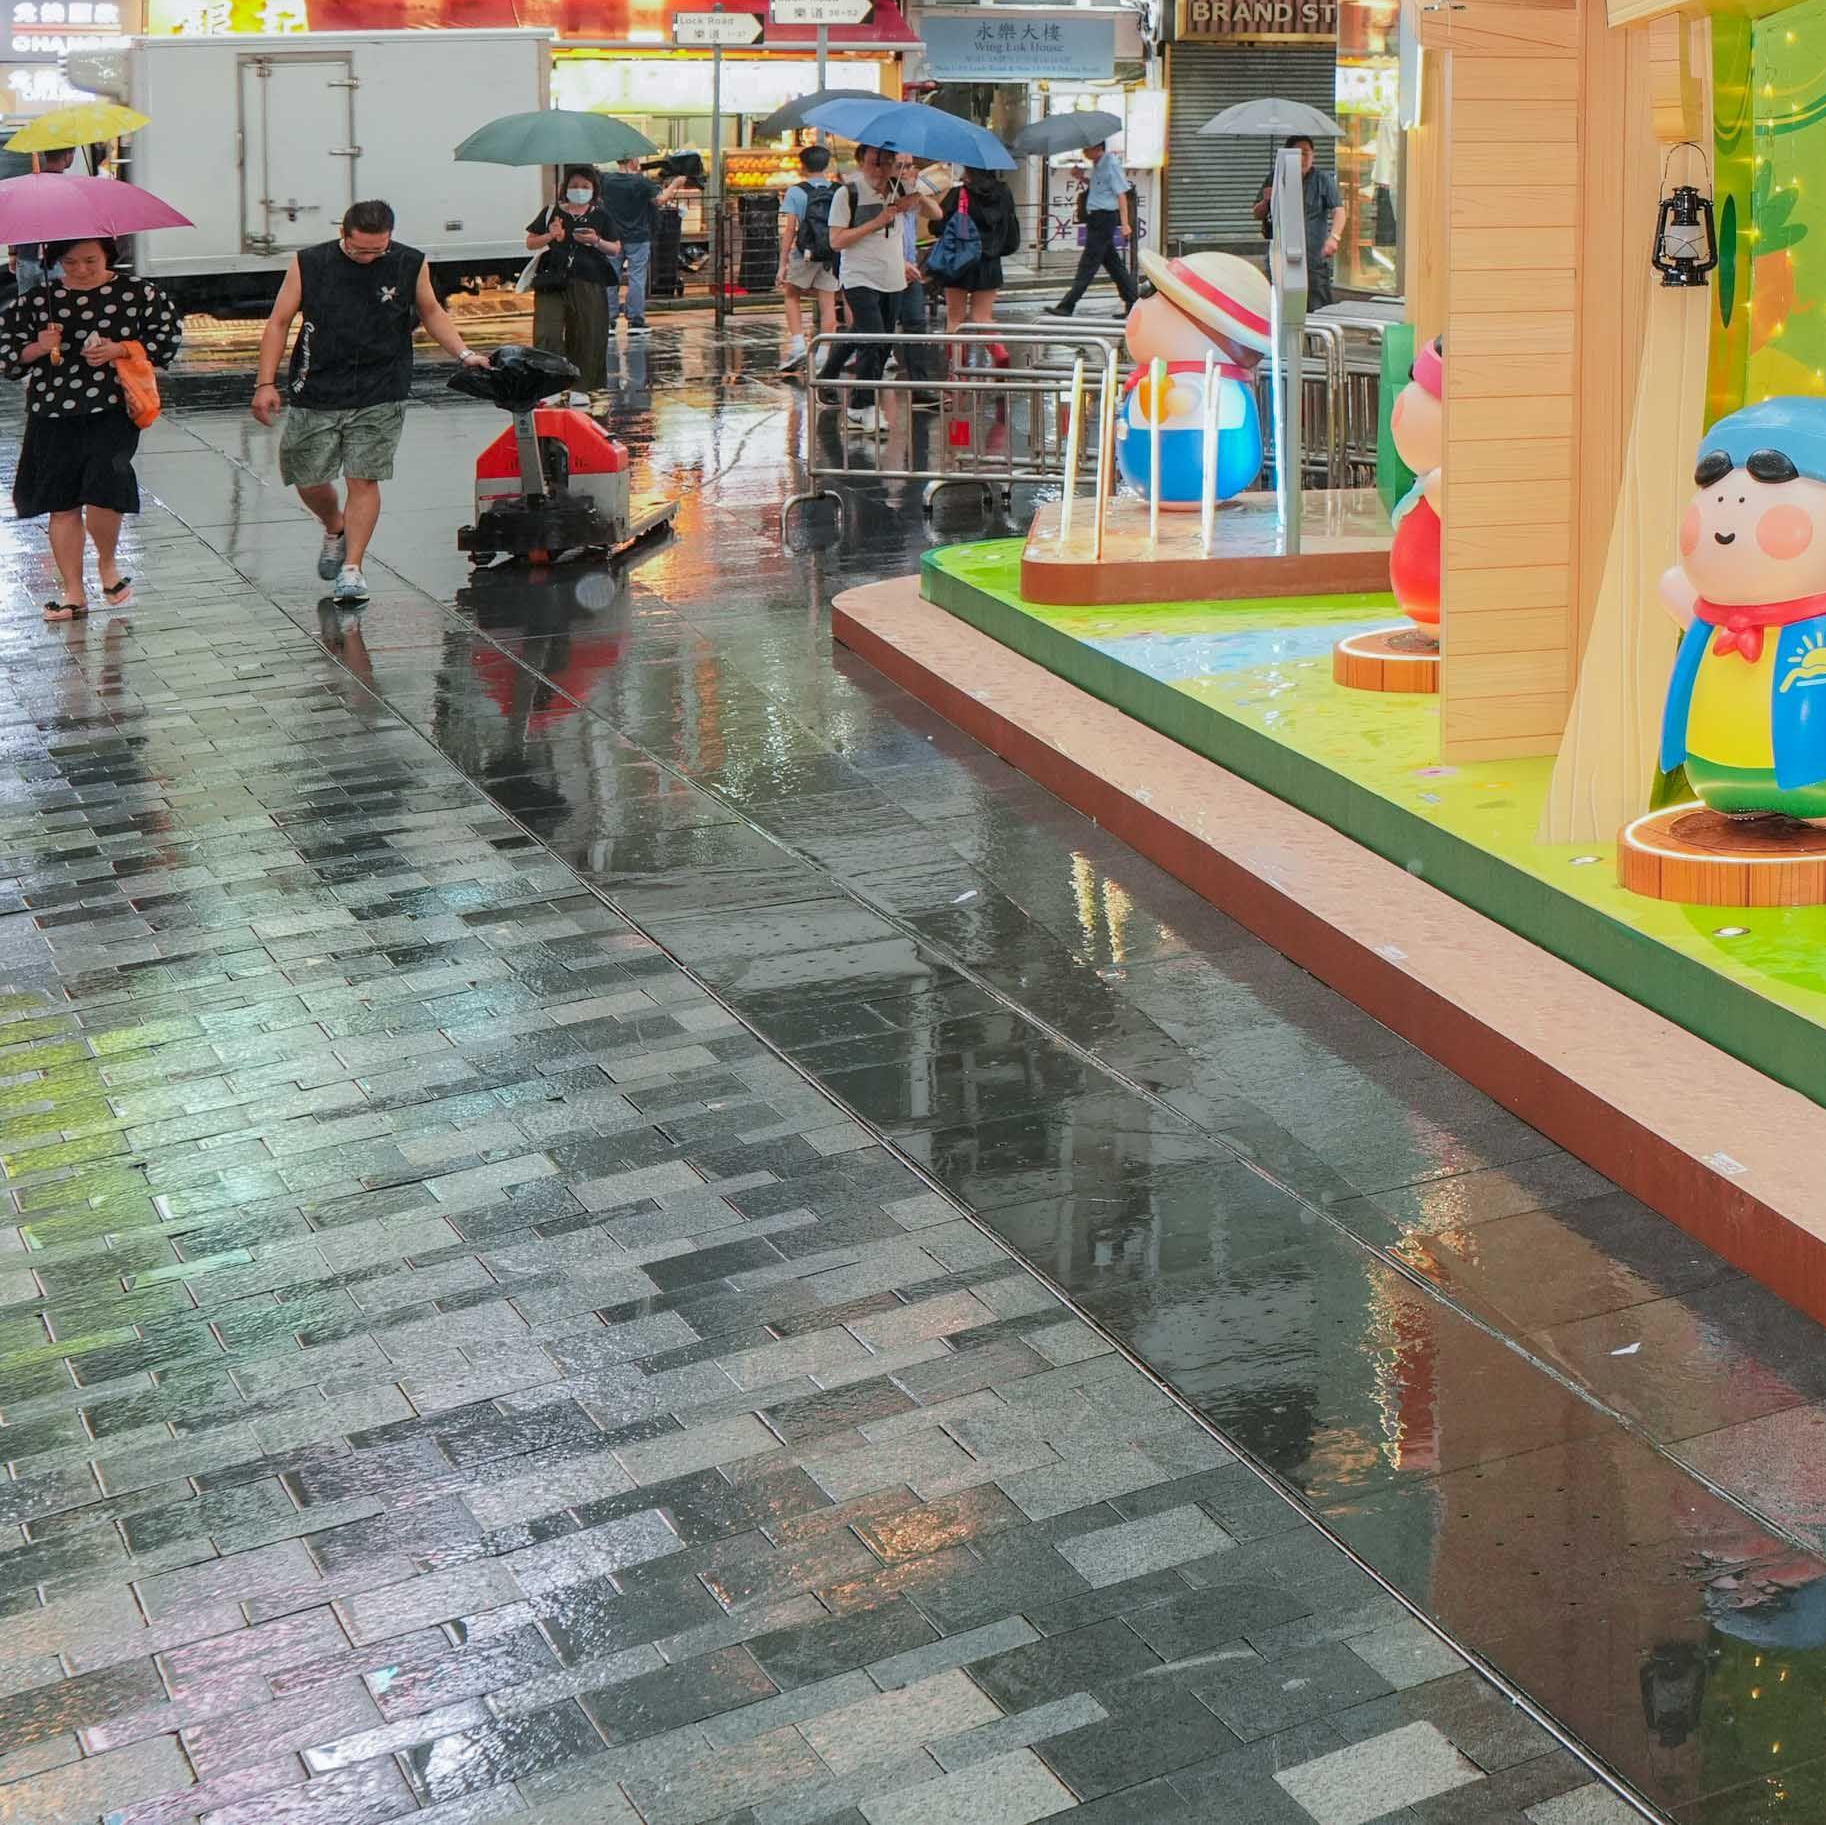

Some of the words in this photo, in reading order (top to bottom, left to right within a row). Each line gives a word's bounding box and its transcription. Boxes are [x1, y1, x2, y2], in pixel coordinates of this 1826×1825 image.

[1192, 2, 1293, 22] BRAND
[680, 16, 703, 25] Lock
[708, 16, 734, 25] Road
[974, 41, 1002, 55] Wing
[1030, 42, 1064, 53] House
